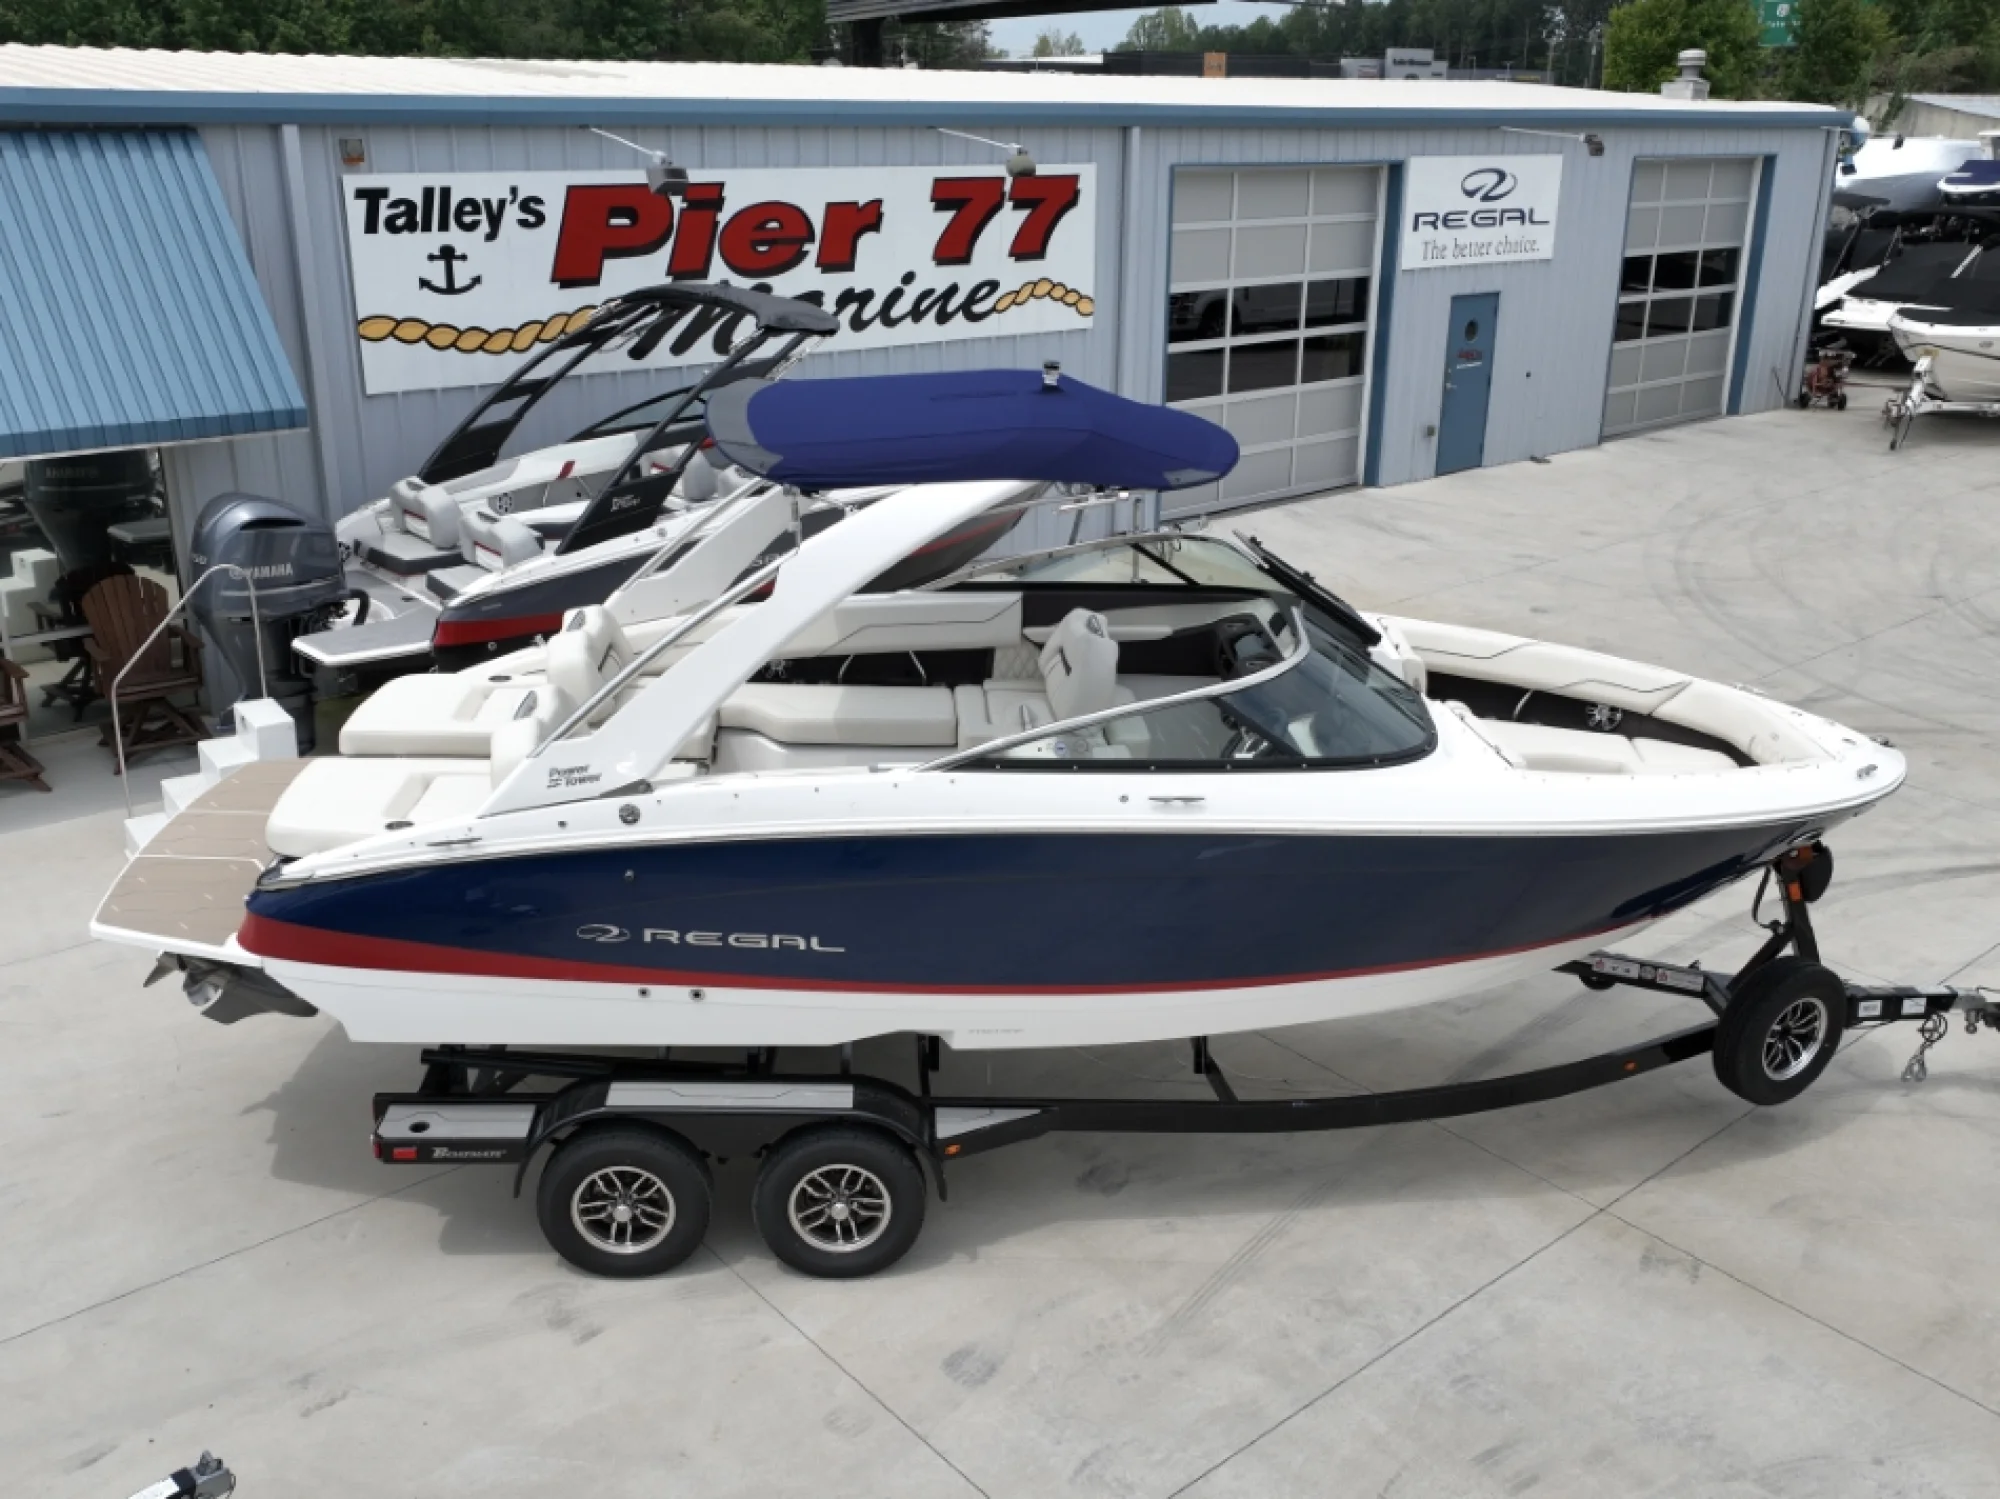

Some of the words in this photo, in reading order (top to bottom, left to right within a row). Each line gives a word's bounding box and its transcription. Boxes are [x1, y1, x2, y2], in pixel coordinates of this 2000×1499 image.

[354, 185, 546, 242] Talley's
[550, 181, 884, 289] Pier
[929, 174, 1080, 267] 77
[1412, 207, 1550, 232] REGAL
[1422, 238, 1447, 261] The
[1453, 237, 1493, 259] better
[1495, 234, 1540, 256] choice.
[614, 270, 1001, 361] Mrine
[643, 927, 846, 953] REGAL
